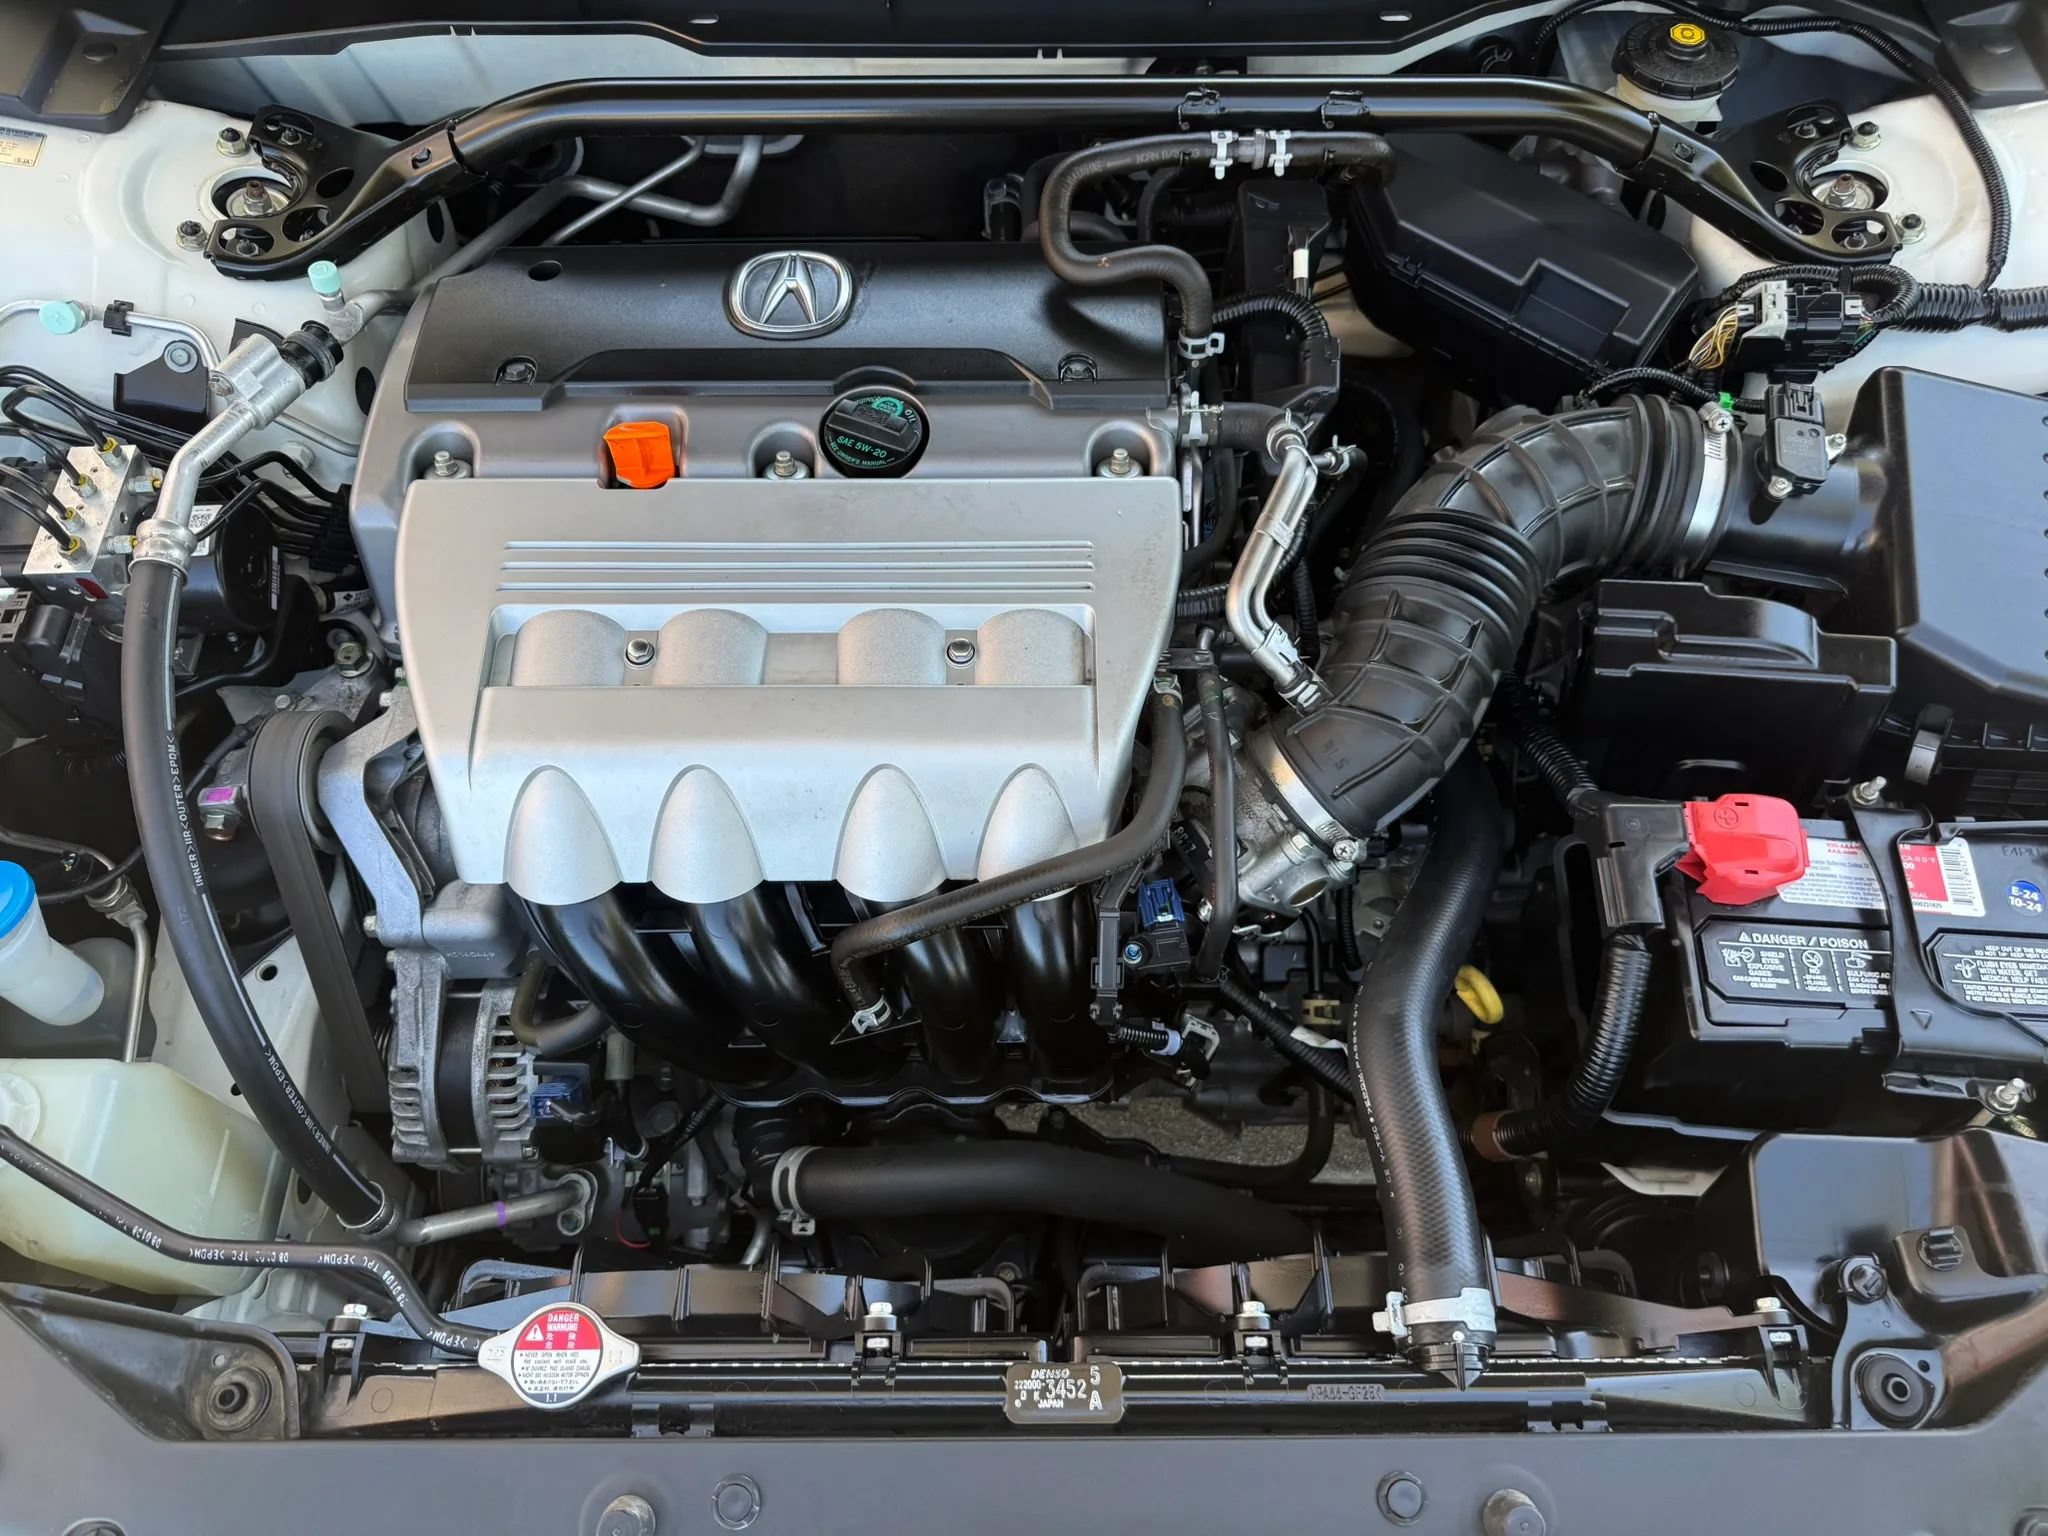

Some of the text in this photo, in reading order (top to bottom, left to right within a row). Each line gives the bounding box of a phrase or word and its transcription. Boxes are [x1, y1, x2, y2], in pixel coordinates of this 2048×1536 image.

[904, 409, 917, 424] OIL
[837, 435, 887, 458] SAE 5W-20
[2011, 886, 2039, 901] E-24
[2009, 896, 2043, 912] 10-24
[1752, 933, 1806, 946] DANGER
[1819, 937, 1868, 949] POISON
[1976, 960, 1999, 968] FLUSH
[1999, 961, 2018, 969] EYES
[1978, 967, 1997, 975] WITH
[2023, 969, 2038, 977] GET
[1980, 974, 2010, 982] MEDICAL
[548, 1313, 580, 1322] DANGER
[547, 1323, 579, 1332] WARNUNG
[1031, 1368, 1070, 1379] DENSO
[1090, 1365, 1101, 1385] 5
[546, 1393, 557, 1403] 1.1
[1038, 1398, 1064, 1408] JAPAN
[1089, 1390, 1103, 1410] A
